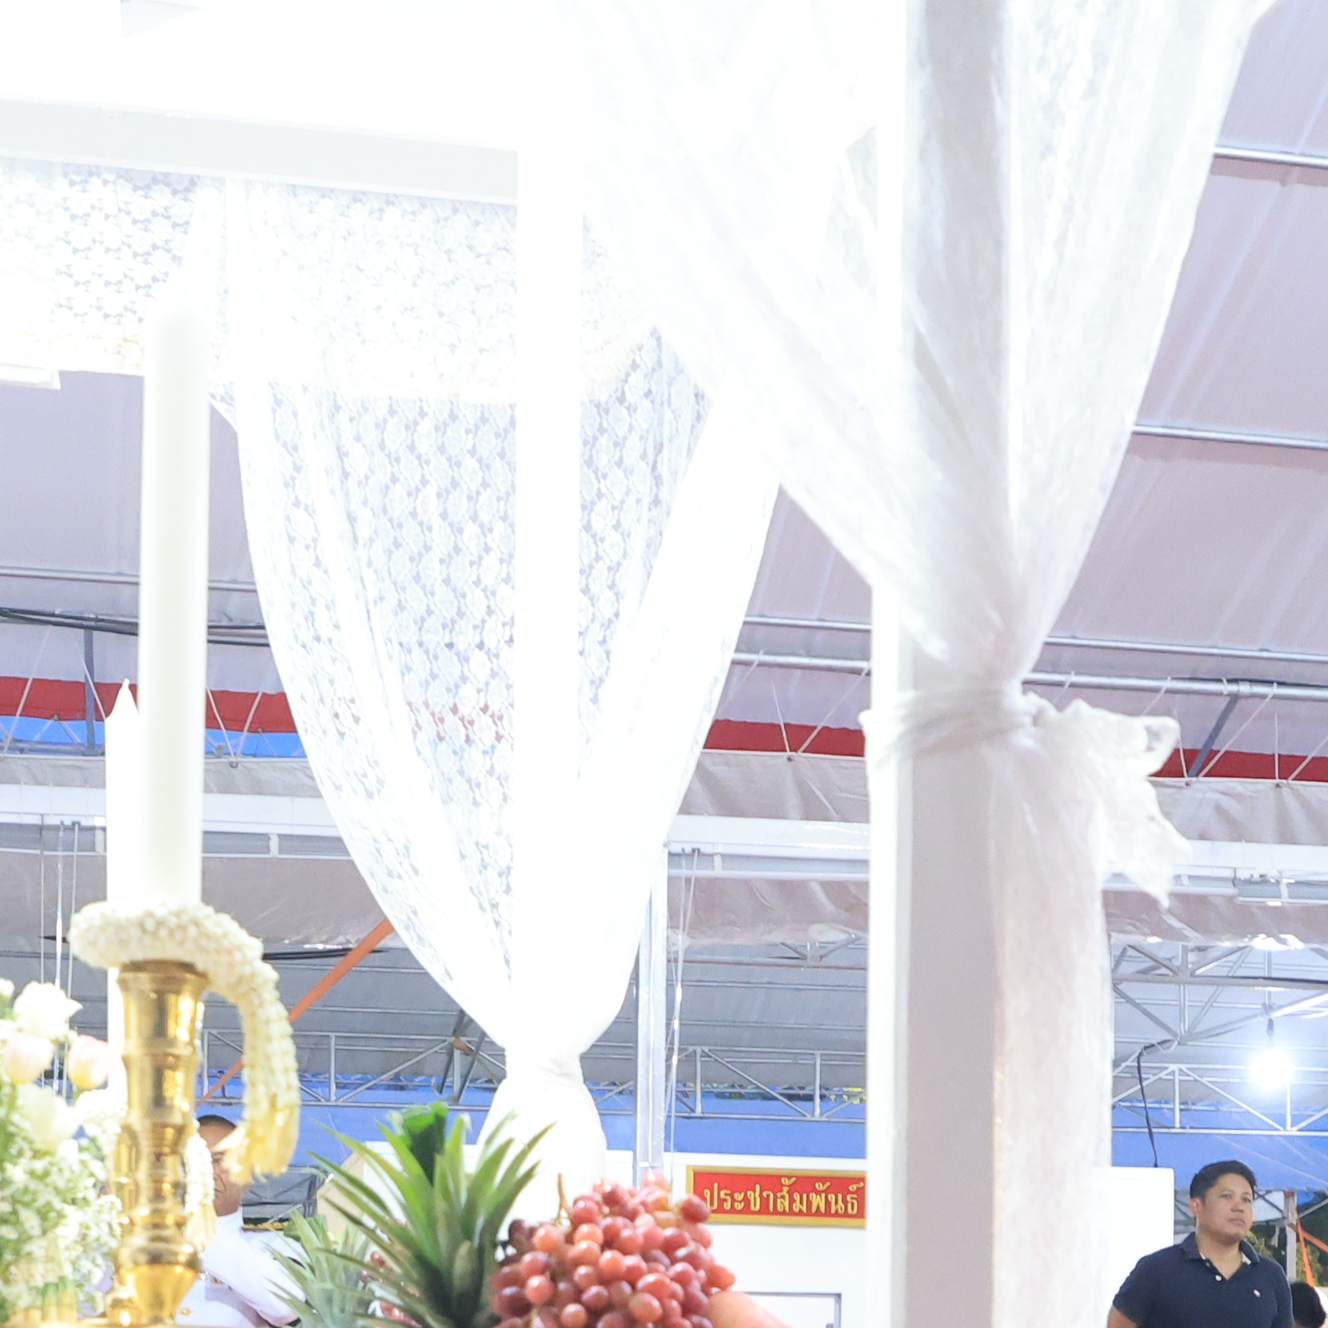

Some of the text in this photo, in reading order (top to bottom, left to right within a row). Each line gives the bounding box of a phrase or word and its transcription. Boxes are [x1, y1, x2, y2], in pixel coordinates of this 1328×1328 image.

[703, 1176, 864, 1215] ประชาสัมพันธ์
